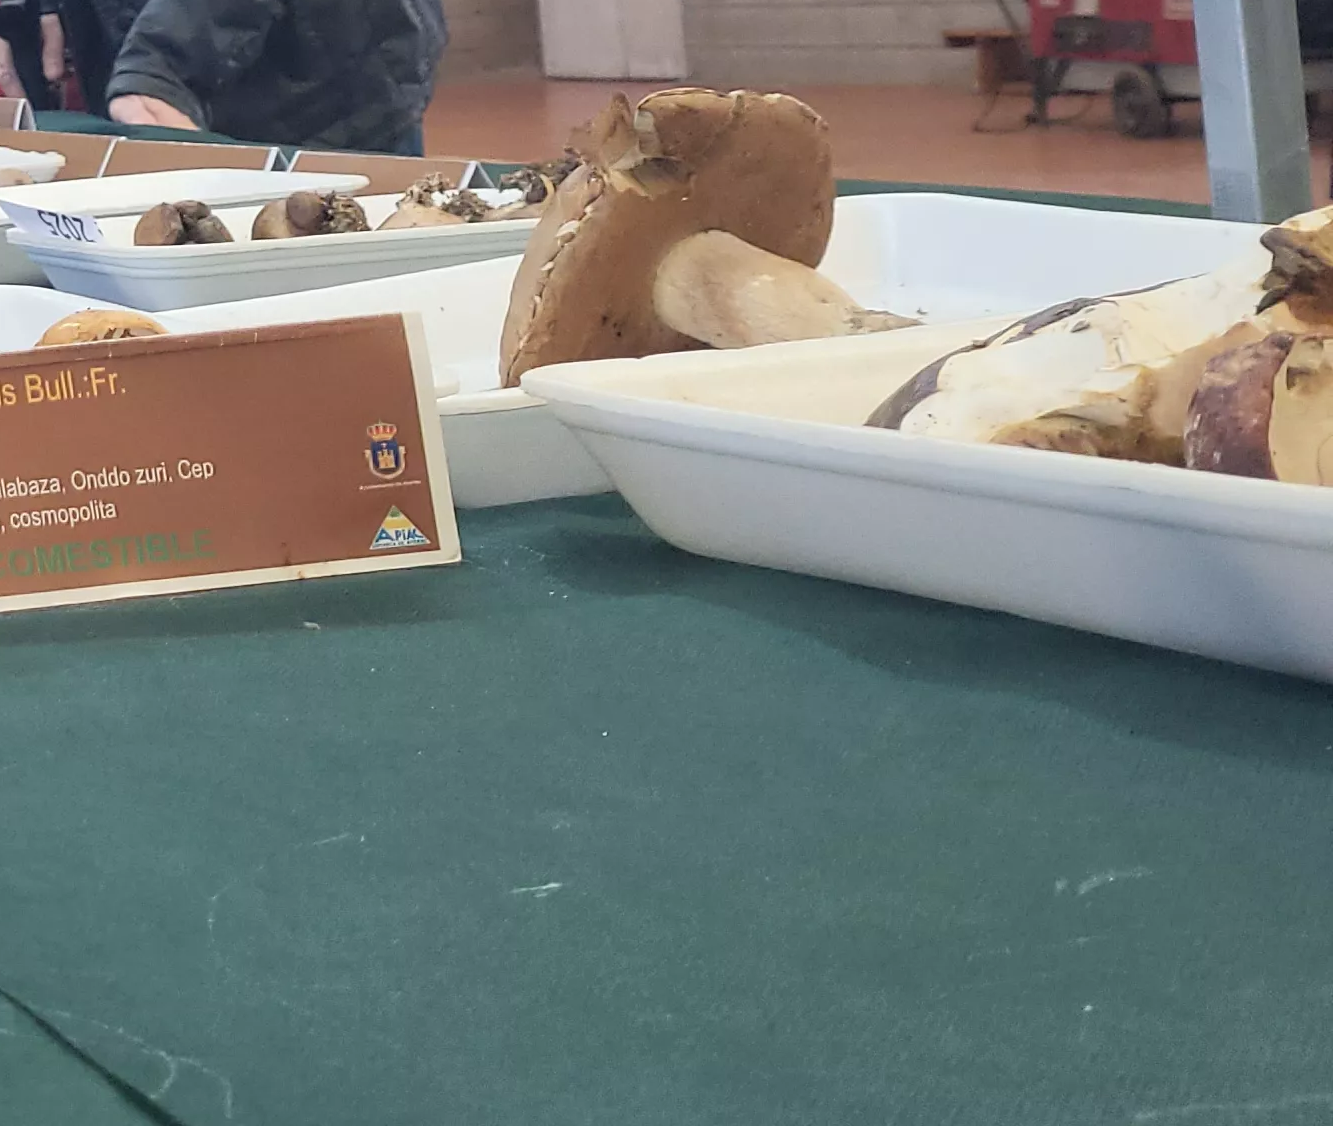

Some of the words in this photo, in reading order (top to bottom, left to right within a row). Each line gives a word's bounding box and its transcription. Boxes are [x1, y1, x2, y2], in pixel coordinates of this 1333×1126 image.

[71, 465, 131, 491] Onddo
[177, 459, 214, 481] Cep
[9, 499, 118, 528] cosmopolita
